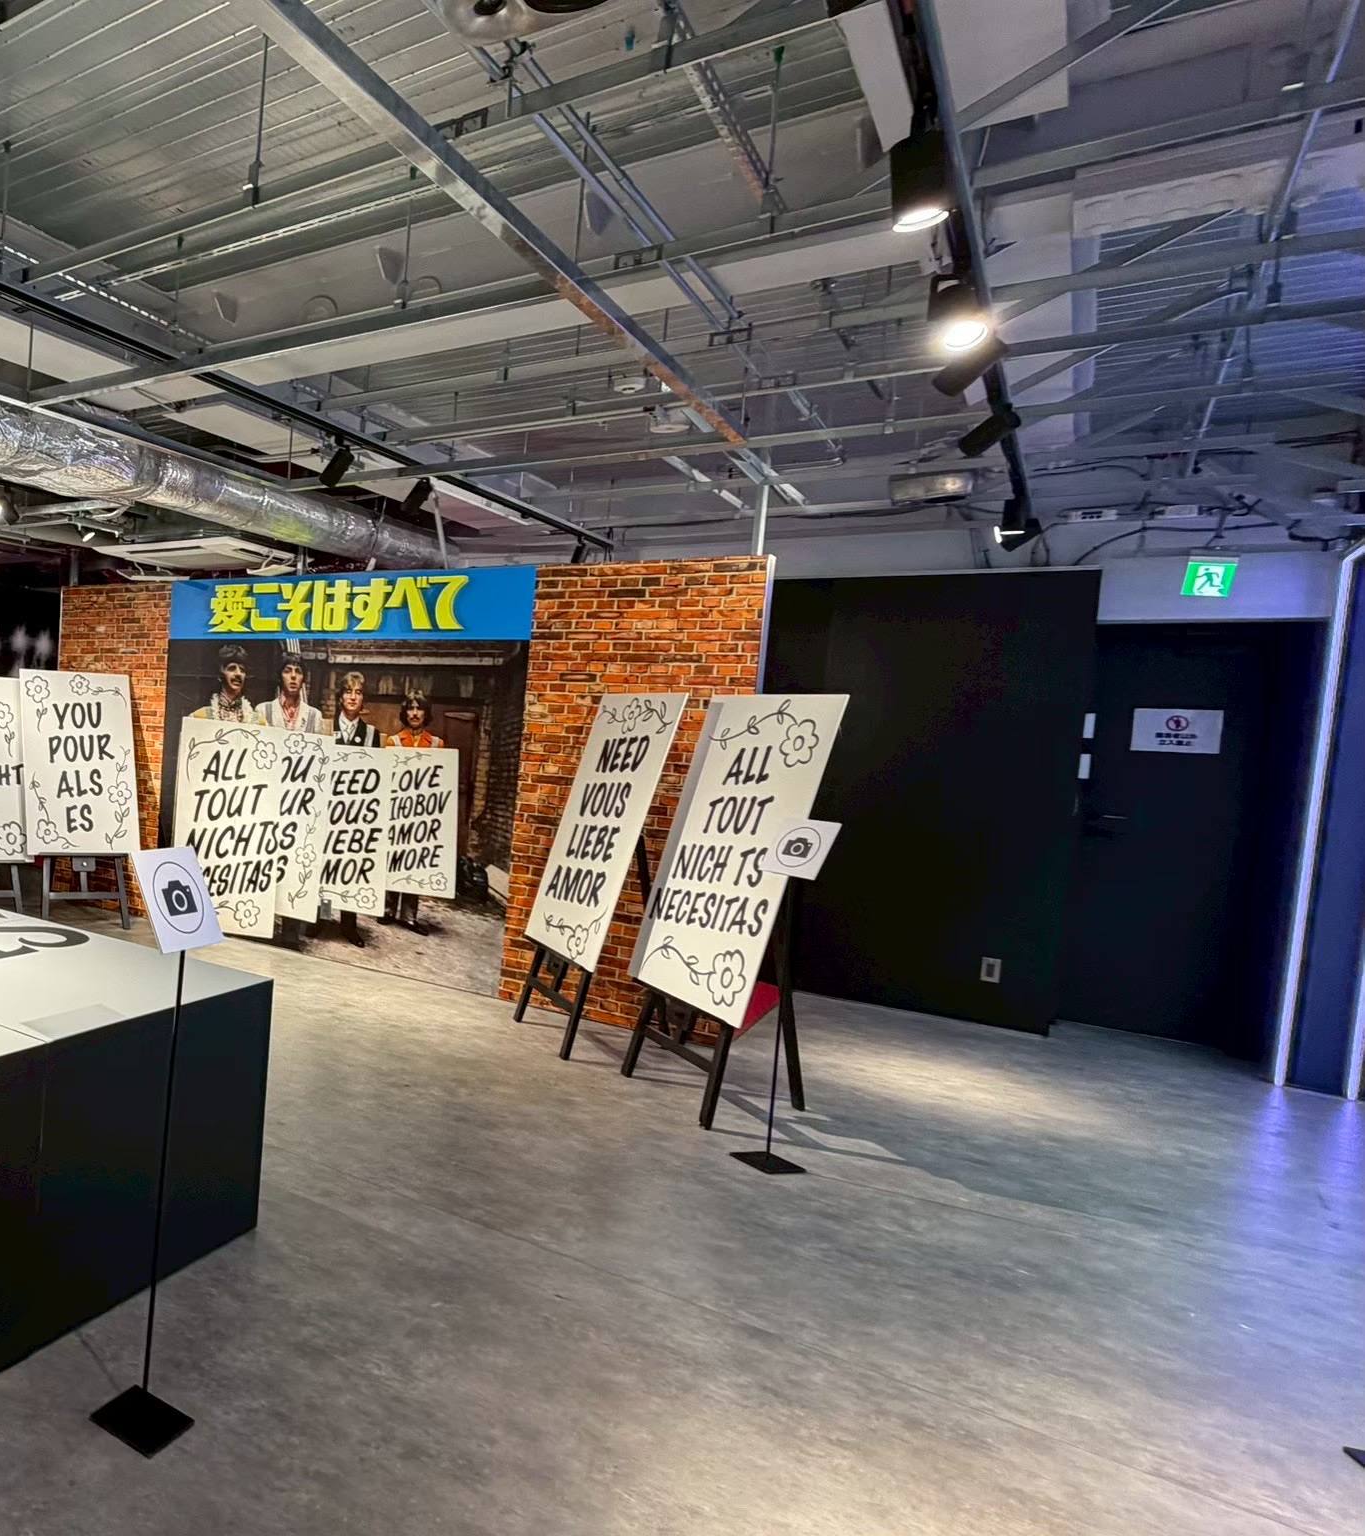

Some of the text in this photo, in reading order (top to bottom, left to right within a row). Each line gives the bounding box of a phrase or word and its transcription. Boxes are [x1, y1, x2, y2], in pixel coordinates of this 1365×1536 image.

[208, 574, 470, 634] 愛こそはすべて
[53, 701, 103, 730] YOU
[48, 733, 116, 763] POUR
[201, 748, 249, 783] ALL
[595, 734, 651, 774] NEED
[722, 744, 774, 786] ALL
[56, 768, 104, 799] ALS
[280, 754, 316, 783] OU
[329, 768, 381, 797] EED
[193, 783, 269, 823] TOUT
[327, 798, 381, 825] OUS
[578, 780, 632, 819] VOUS
[702, 794, 775, 835] TOUT
[65, 804, 94, 834] ES
[323, 827, 383, 855] IEBE
[565, 824, 621, 863] LIEBE
[320, 858, 375, 886] MOR
[545, 864, 607, 908] AMOR
[649, 887, 769, 938] NECESITAS
